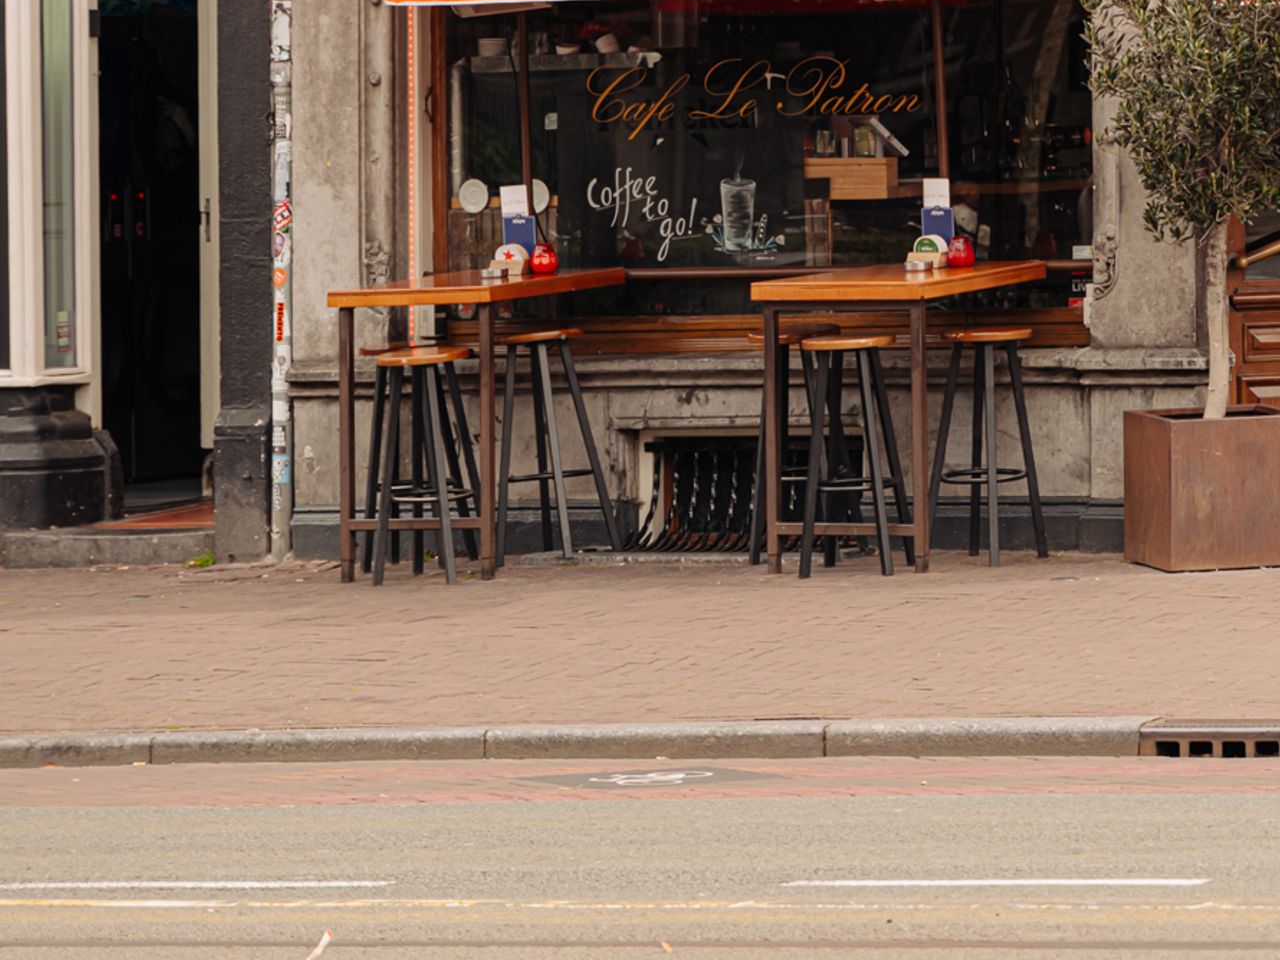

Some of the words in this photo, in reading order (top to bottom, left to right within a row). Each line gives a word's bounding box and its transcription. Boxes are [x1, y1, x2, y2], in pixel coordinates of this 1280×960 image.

[688, 58, 772, 120] Le
[776, 55, 922, 117] Patron
[586, 166, 659, 228] Coffee
[641, 196, 669, 221] to
[658, 197, 698, 262] go!
